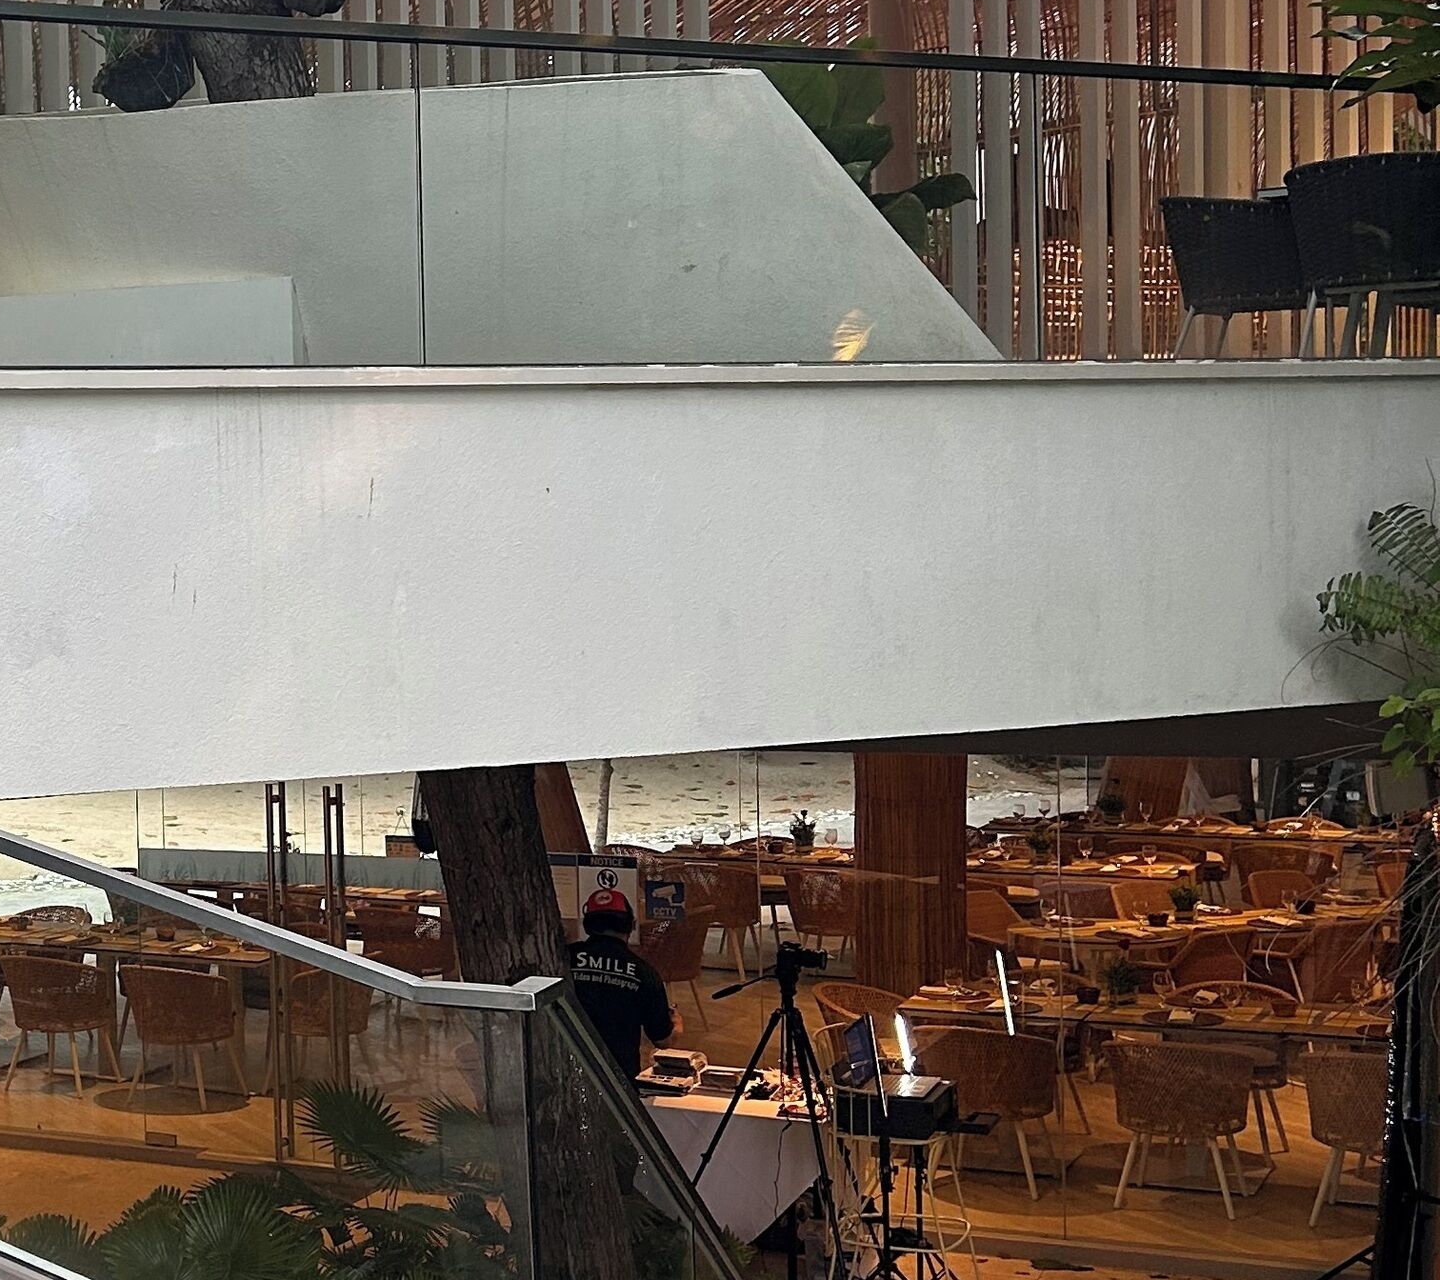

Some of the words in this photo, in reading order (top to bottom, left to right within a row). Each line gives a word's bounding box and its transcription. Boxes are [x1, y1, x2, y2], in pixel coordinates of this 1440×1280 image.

[590, 857, 625, 866] NOTICE
[652, 907, 677, 917] CCTV
[576, 951, 637, 976] SMILE
